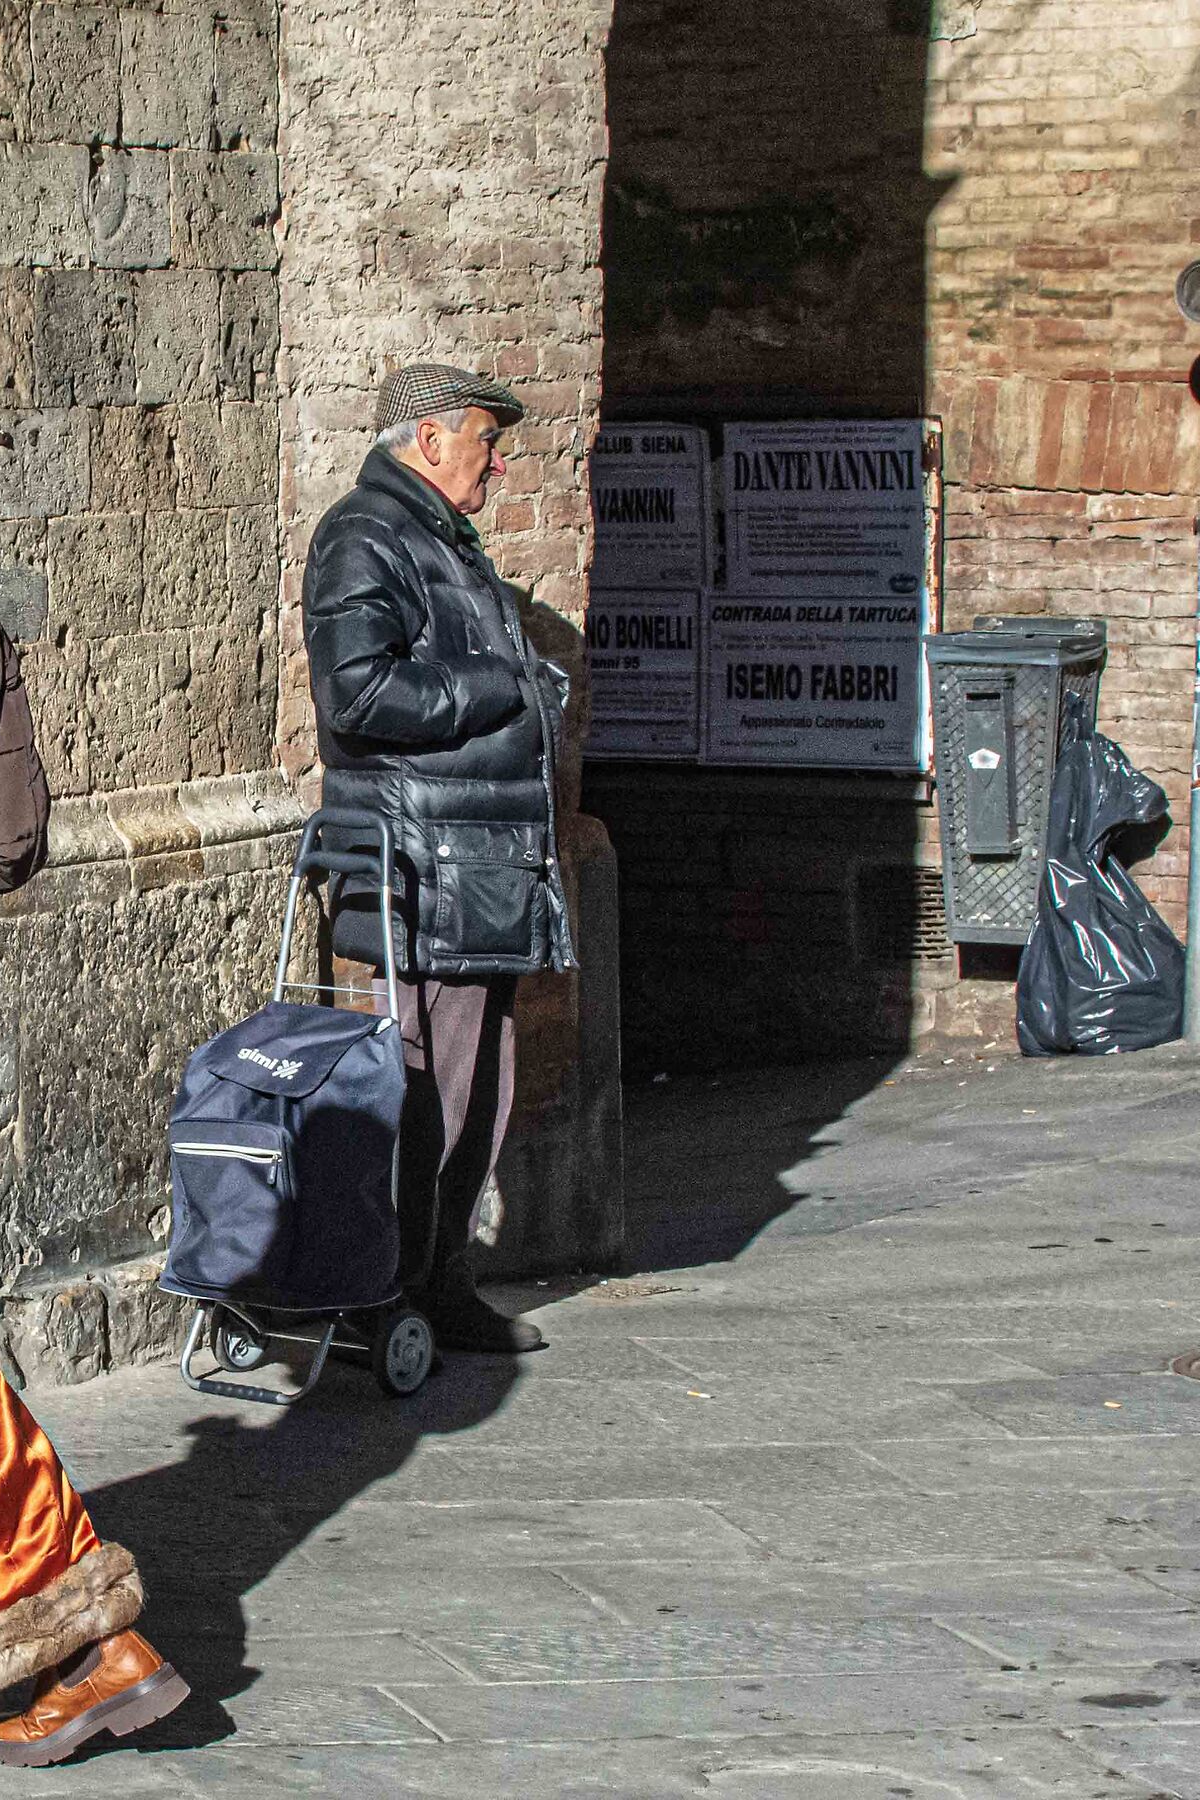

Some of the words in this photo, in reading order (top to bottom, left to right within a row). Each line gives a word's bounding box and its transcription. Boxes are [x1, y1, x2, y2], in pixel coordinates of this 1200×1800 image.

[594, 436, 633, 454] CLUB
[641, 436, 686, 454] SIENA
[734, 450, 812, 491] DANTE
[814, 449, 916, 491] VANNINI
[595, 487, 675, 523] VANNINI
[711, 605, 791, 623] CONTRADA
[796, 606, 842, 623] DELLA
[848, 607, 917, 624] TARTUCA
[616, 615, 692, 650] BONELLI
[726, 663, 802, 701] ISEMO
[810, 665, 899, 702] FABBRI
[739, 714, 812, 731] Appassionato
